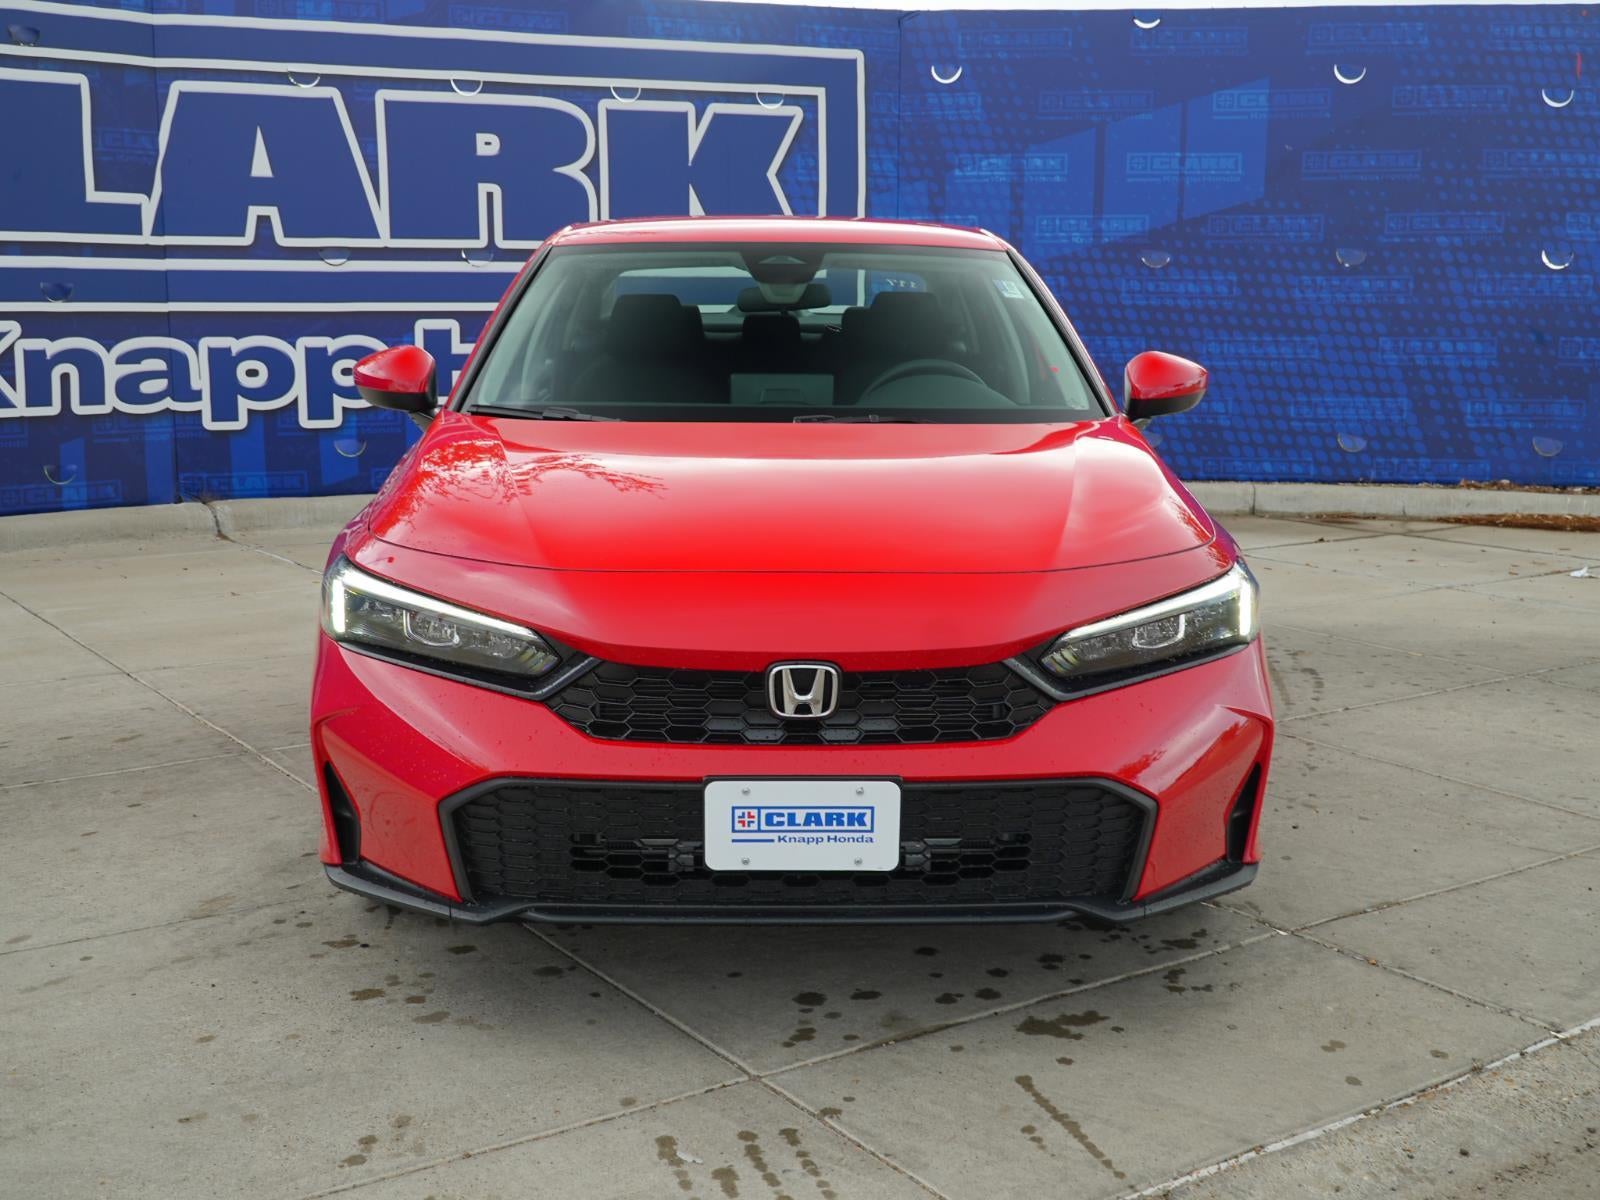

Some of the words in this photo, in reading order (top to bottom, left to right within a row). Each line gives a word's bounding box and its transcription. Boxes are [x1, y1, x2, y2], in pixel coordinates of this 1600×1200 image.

[764, 811, 868, 827] CLARK
[777, 835, 824, 845] Knapp
[827, 835, 874, 844] Honda
